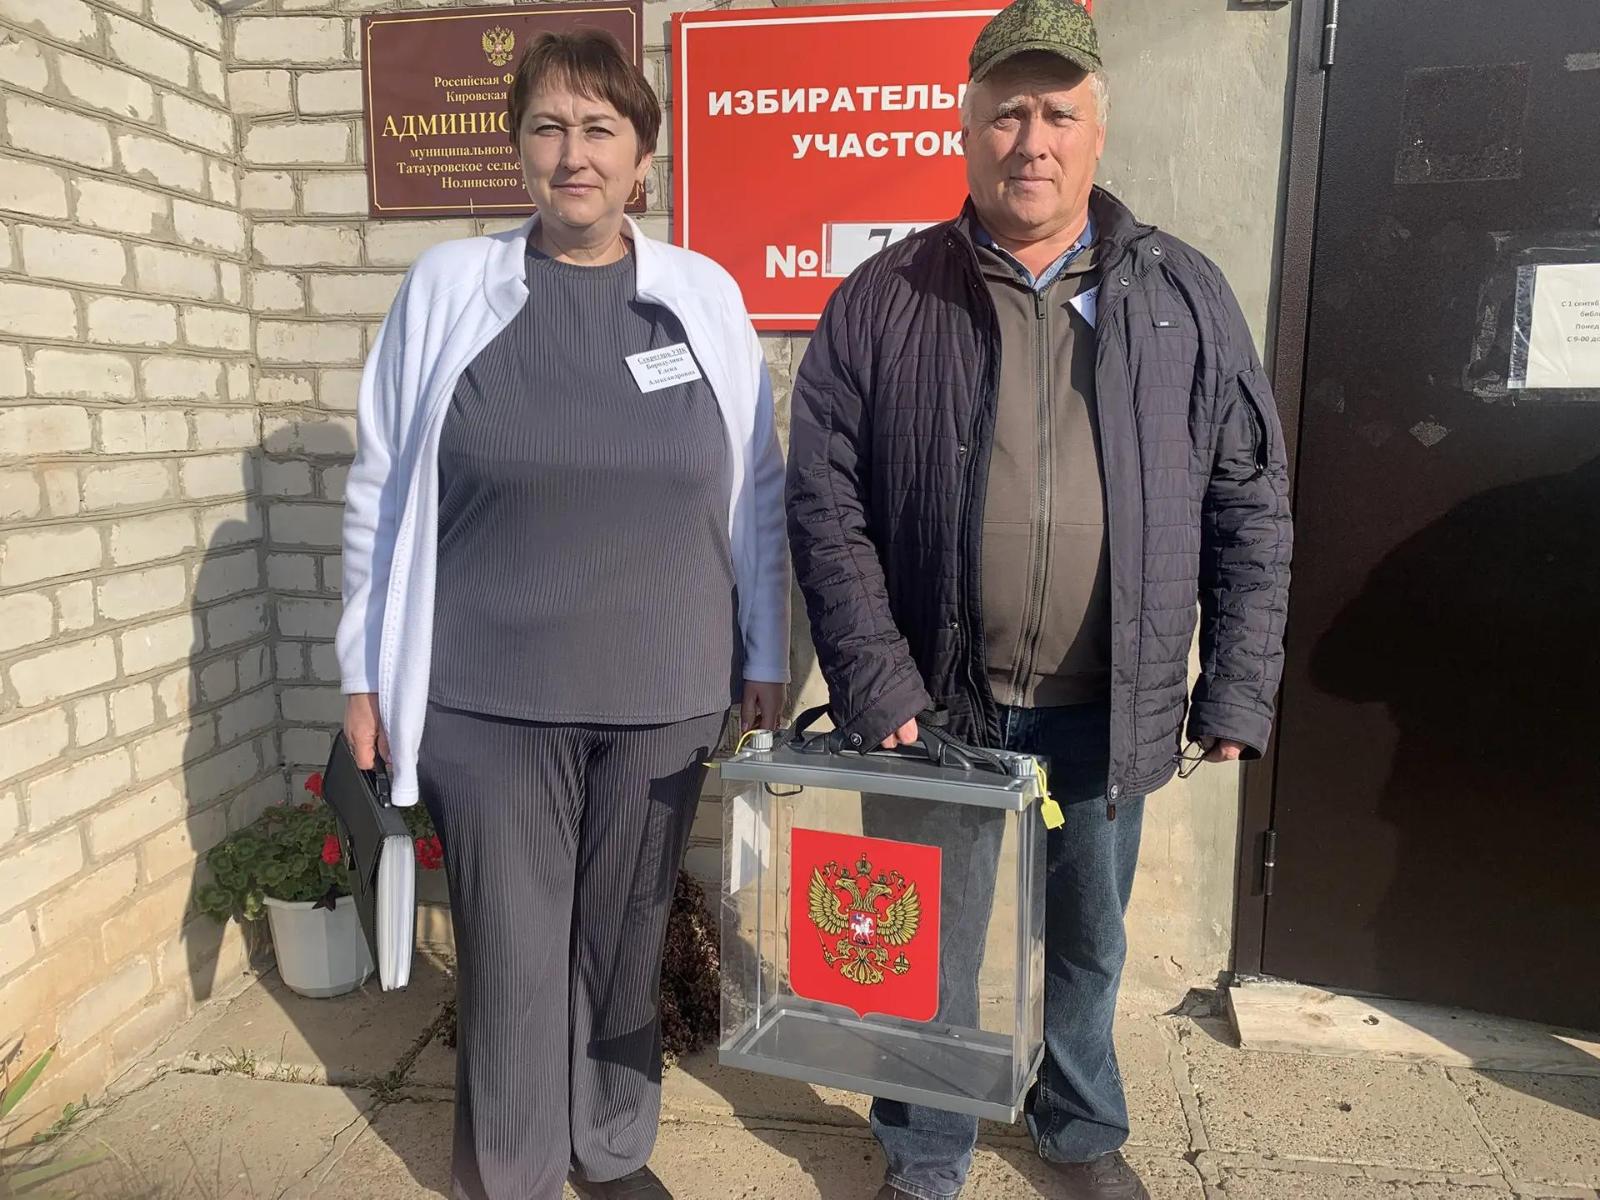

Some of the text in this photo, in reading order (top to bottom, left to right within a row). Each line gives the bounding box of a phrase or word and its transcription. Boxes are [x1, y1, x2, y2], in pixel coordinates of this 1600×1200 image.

[434, 73, 514, 88] Российская Ф
[446, 90, 507, 104] Кировская
[410, 145, 513, 159] муниципального
[792, 131, 964, 159] УЧАСТОК
[397, 161, 521, 176] Татауровское сельс
[442, 176, 517, 189] Нолинского
[765, 244, 819, 278] №
